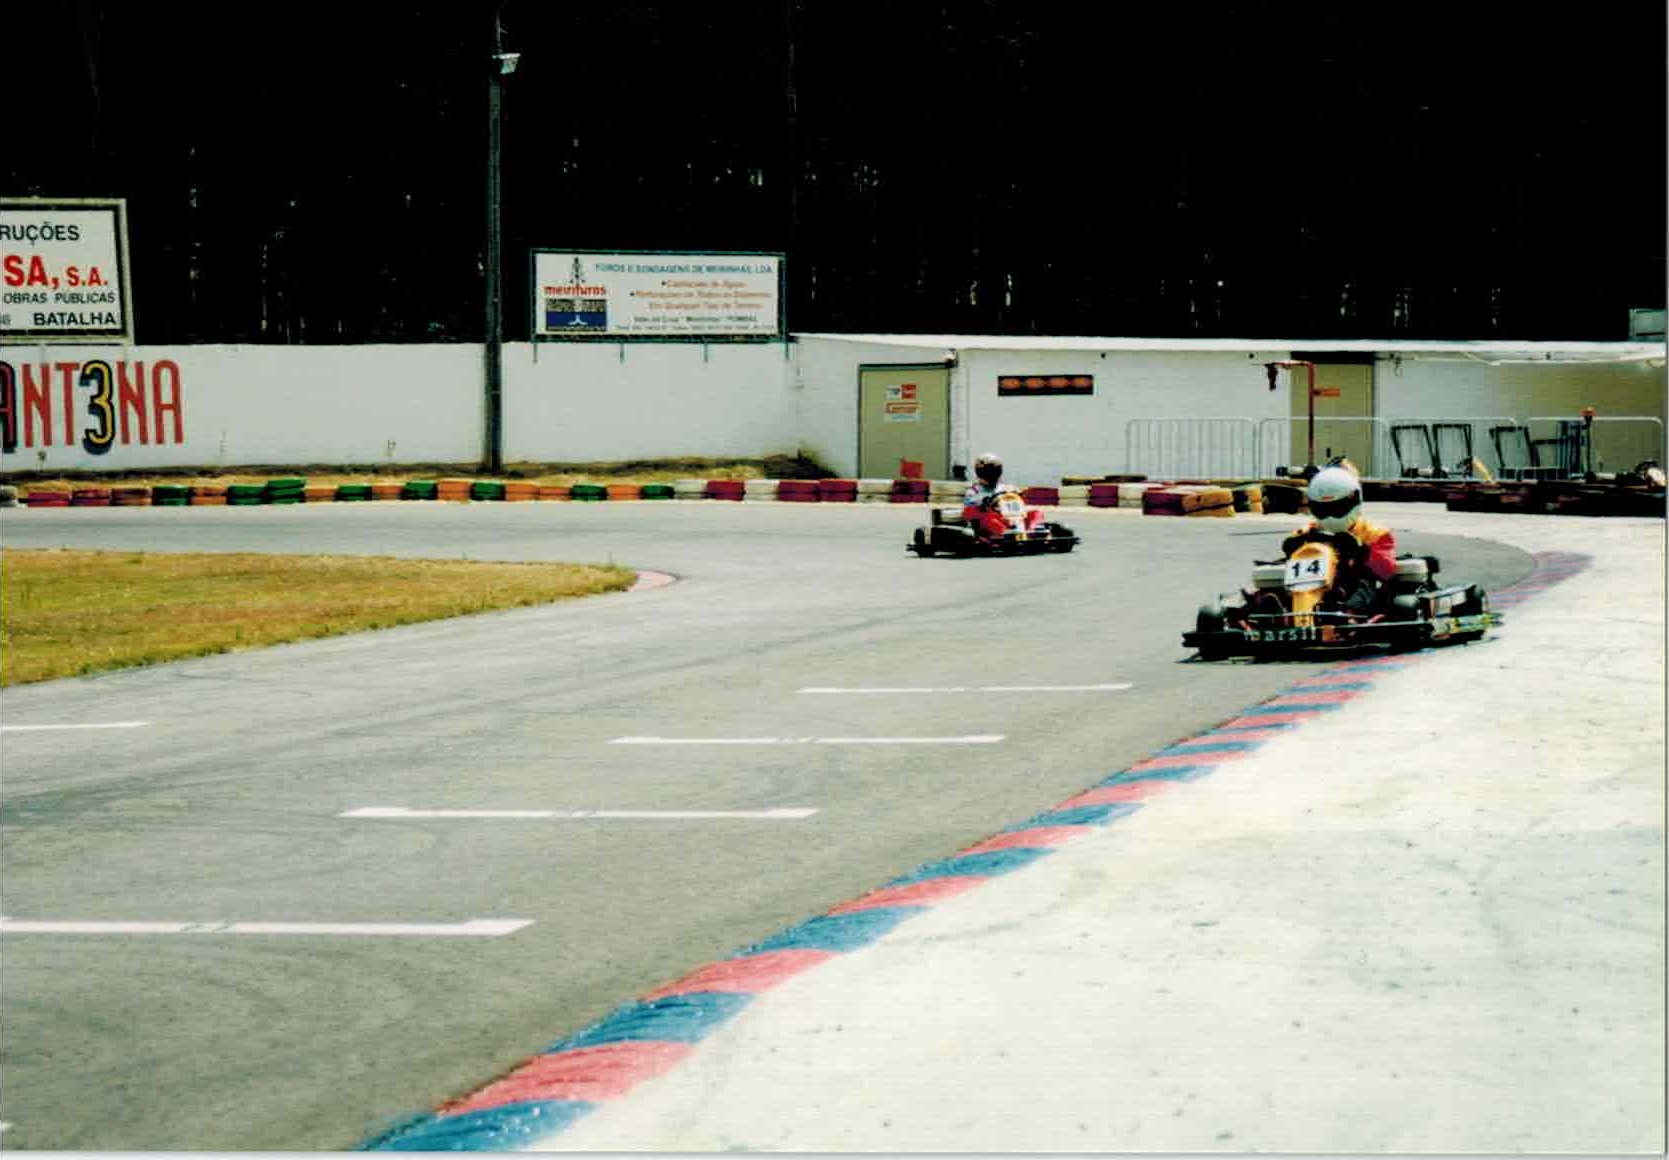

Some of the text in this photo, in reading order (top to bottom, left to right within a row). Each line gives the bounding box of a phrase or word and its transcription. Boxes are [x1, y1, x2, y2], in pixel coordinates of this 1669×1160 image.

[0, 221, 80, 245] RUÇÕES
[4, 255, 109, 290] SA, S.A.
[4, 293, 47, 304] OBRAS
[34, 312, 116, 325] BATALHA
[1291, 560, 1320, 577] 14
